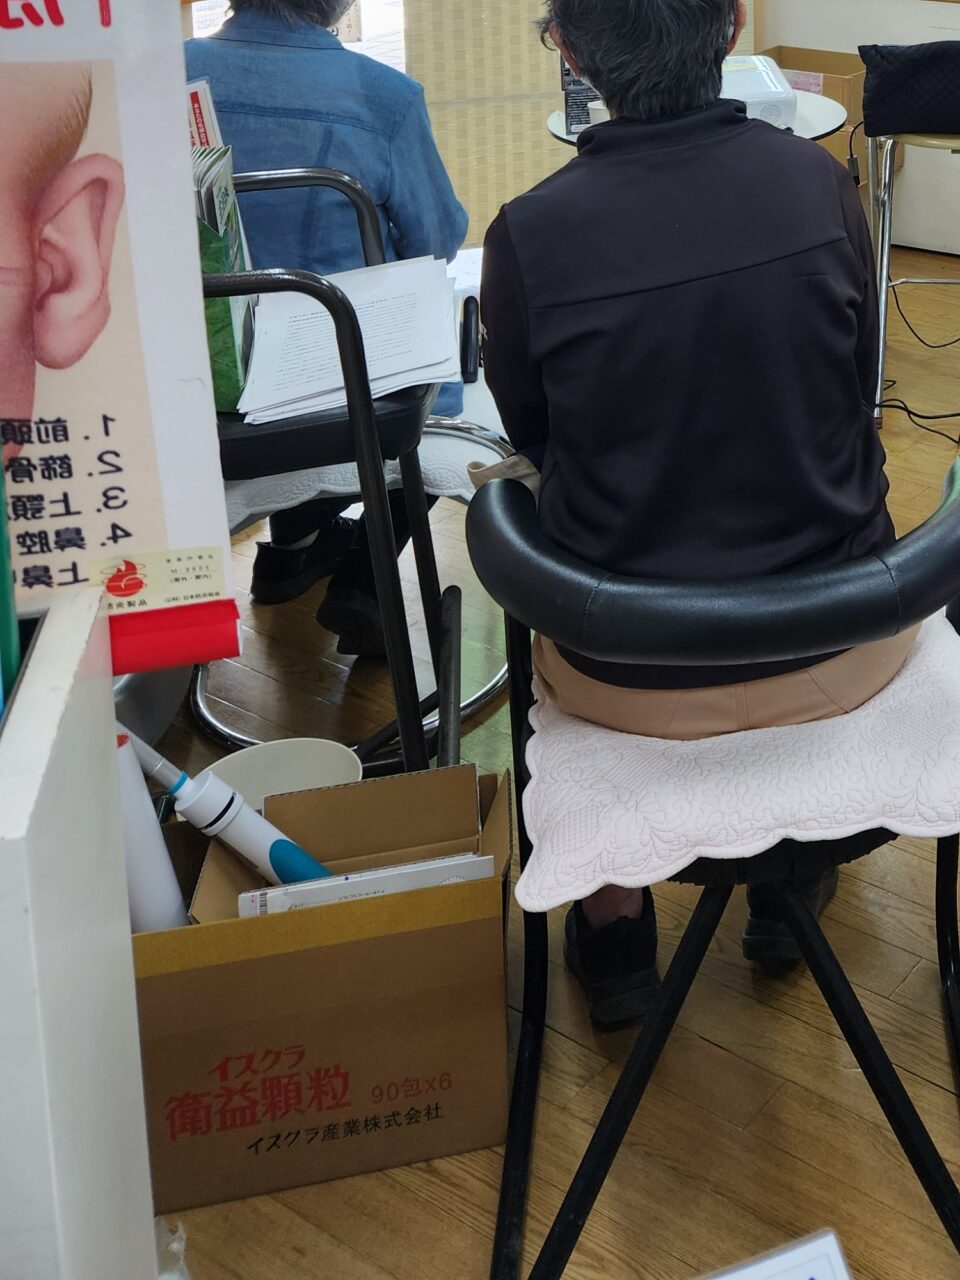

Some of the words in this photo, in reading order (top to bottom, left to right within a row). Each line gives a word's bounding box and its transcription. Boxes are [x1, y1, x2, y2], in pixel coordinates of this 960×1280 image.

[208, 1044, 306, 1082] イスクラ
[164, 1063, 352, 1141] 衛益顆粒
[246, 1102, 443, 1156] イスクラ産業株式会社
